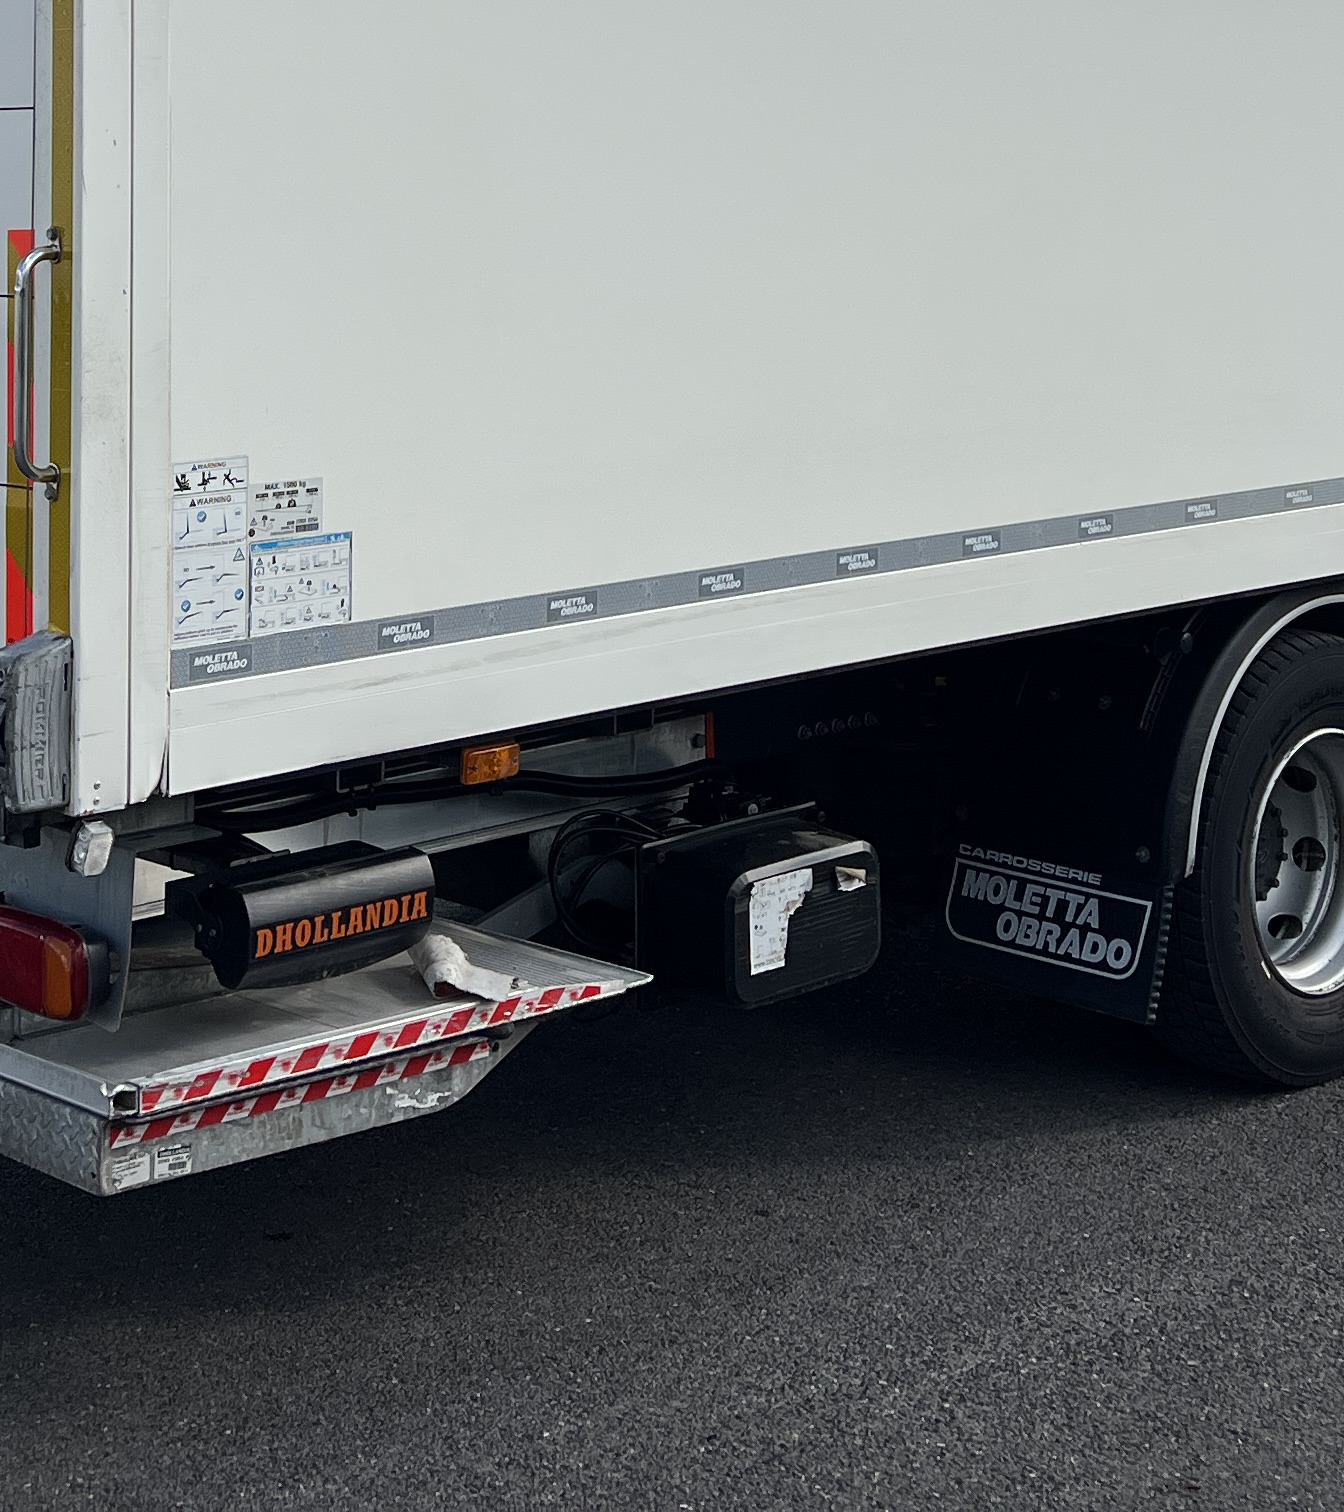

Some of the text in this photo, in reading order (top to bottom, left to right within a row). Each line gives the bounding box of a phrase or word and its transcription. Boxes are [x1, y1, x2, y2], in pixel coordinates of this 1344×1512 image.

[197, 495, 232, 505] WARNING
[550, 596, 586, 609] MOLETTA
[382, 621, 421, 636] MOLETTA
[393, 629, 430, 644] OBRADO
[193, 651, 238, 666] MOLETTA
[206, 658, 248, 674] OBRADO
[959, 843, 1103, 886] CARROSSERIE
[961, 868, 1100, 929] MOLETTA
[255, 891, 428, 959] DHOLLANDIA
[996, 911, 1132, 970] OBRADO
